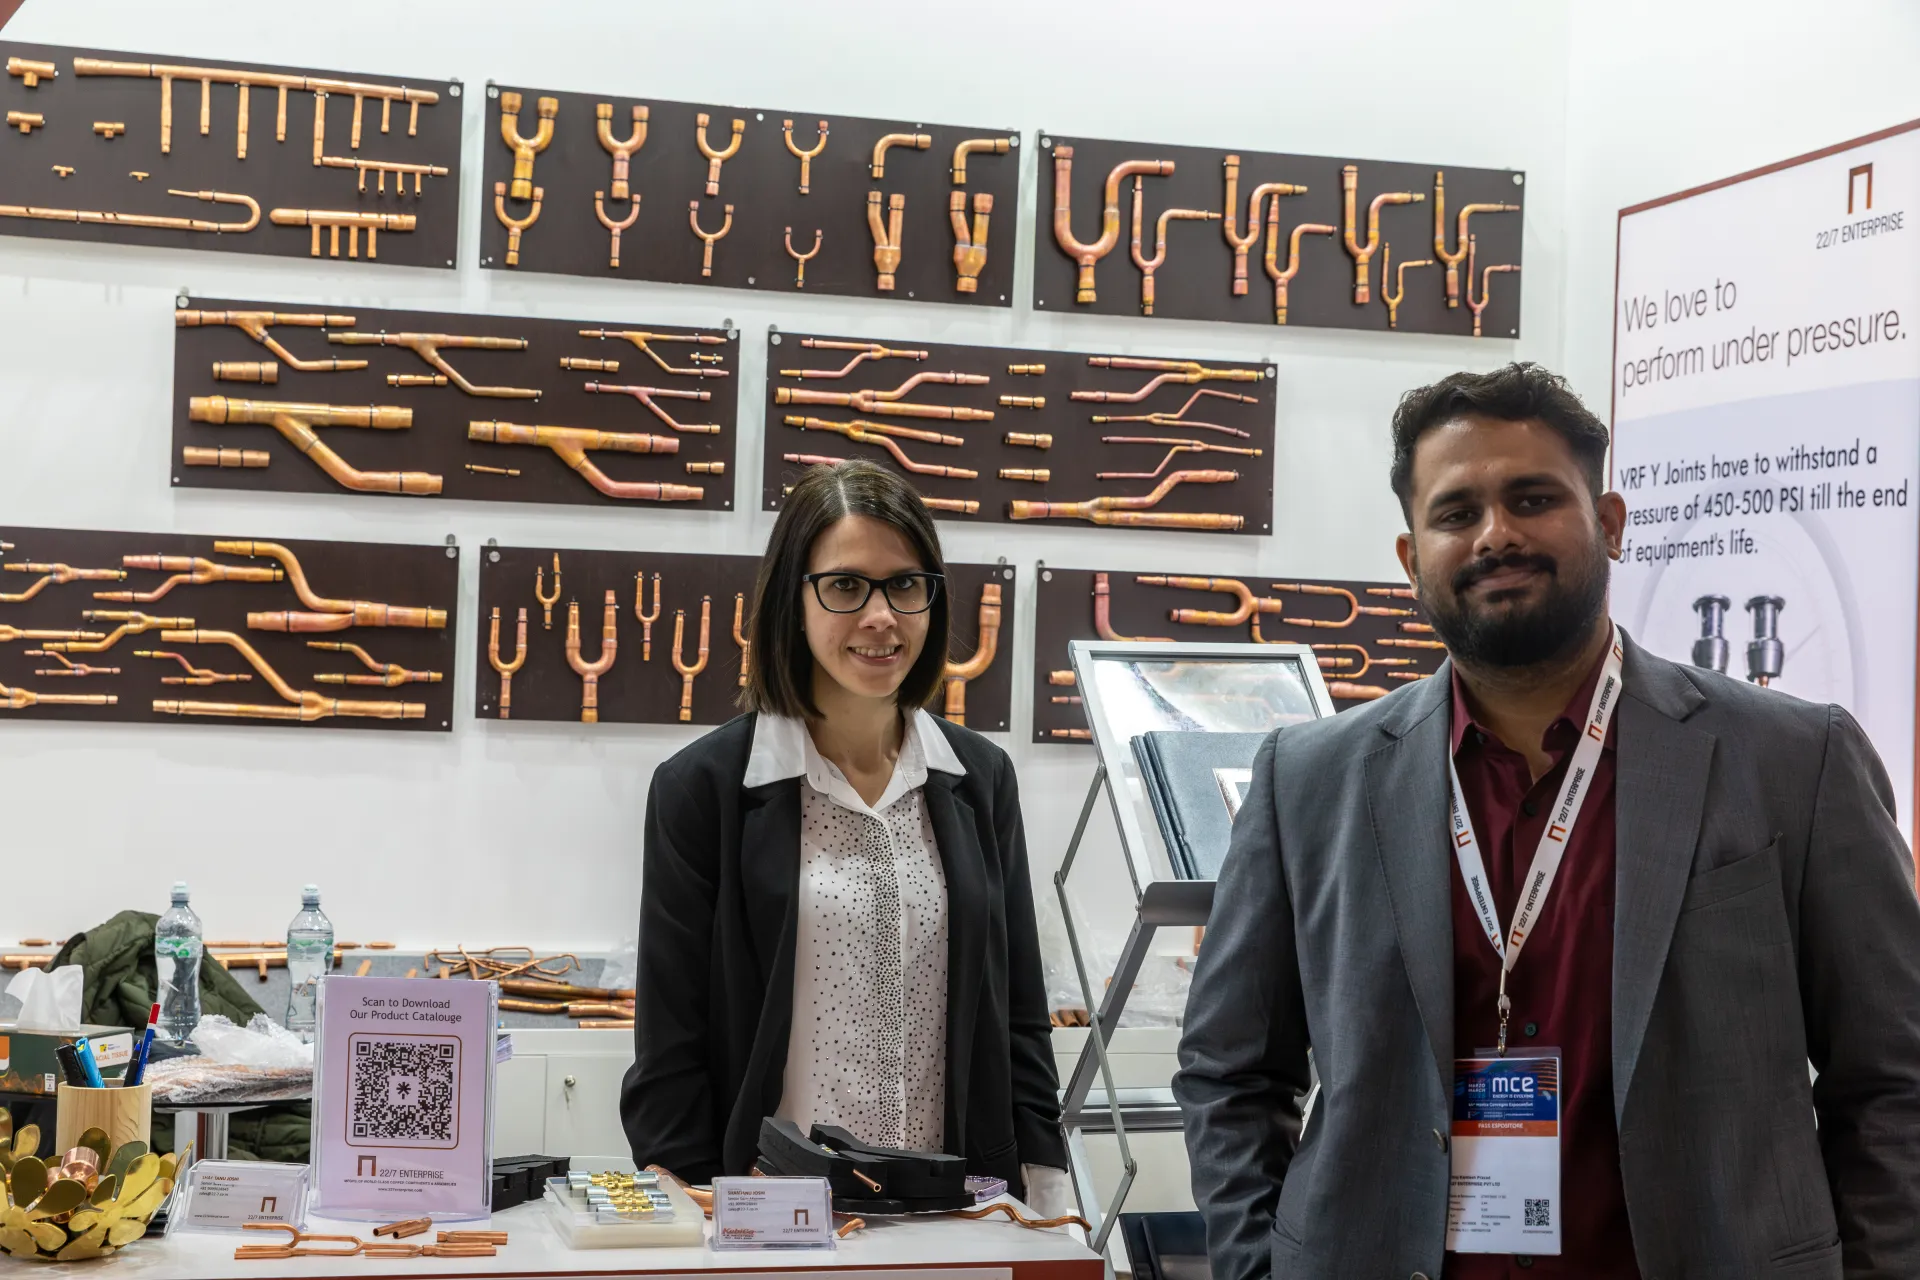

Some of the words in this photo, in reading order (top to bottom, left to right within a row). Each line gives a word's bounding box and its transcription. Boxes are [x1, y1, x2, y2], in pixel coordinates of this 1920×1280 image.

[1816, 228, 1839, 250] 22/7
[1842, 211, 1904, 243] ENTERPRISE
[1624, 296, 1657, 332] We
[1664, 288, 1707, 322] love
[1715, 277, 1737, 311] to
[1623, 346, 1704, 397] perform
[1712, 326, 1779, 370] under
[1788, 308, 1906, 366] pressure.
[1620, 465, 1646, 490] VRF
[1649, 463, 1661, 487] Y
[1664, 458, 1706, 485] Joints
[1711, 454, 1748, 479] have
[1754, 453, 1770, 475] to
[1776, 438, 1859, 471] withstand
[1865, 445, 1878, 464] a
[1684, 494, 1700, 521] of
[1704, 488, 1773, 519] 450-500
[1779, 483, 1804, 512] PSI
[1810, 482, 1831, 511] till
[1837, 481, 1865, 509] the
[1872, 479, 1908, 507] end
[1619, 537, 1633, 564] of
[1636, 534, 1724, 566] equipment's
[1729, 528, 1759, 556] life.
[1599, 675, 1615, 710] ENTERPRISE
[1594, 708, 1605, 725] 22/7
[1558, 807, 1570, 823] 22/7
[1564, 767, 1586, 807] ENTERPRISE
[1454, 815, 1464, 830] 22/7
[1471, 875, 1490, 916] ENTERPRISE
[1518, 912, 1530, 929] 22/7
[1525, 870, 1546, 911] ENTERPRISE
[350, 1009, 367, 1019] Our
[371, 1010, 409, 1021] Product
[412, 1011, 462, 1023] Catalouge
[362, 997, 385, 1007] Scan
[388, 997, 399, 1008] to
[402, 998, 450, 1009] Download
[111, 1050, 129, 1059] TISSUE
[1492, 1077, 1534, 1093] mce
[380, 1169, 397, 1178] 22/7
[399, 1169, 444, 1179] ENTERPRISE
